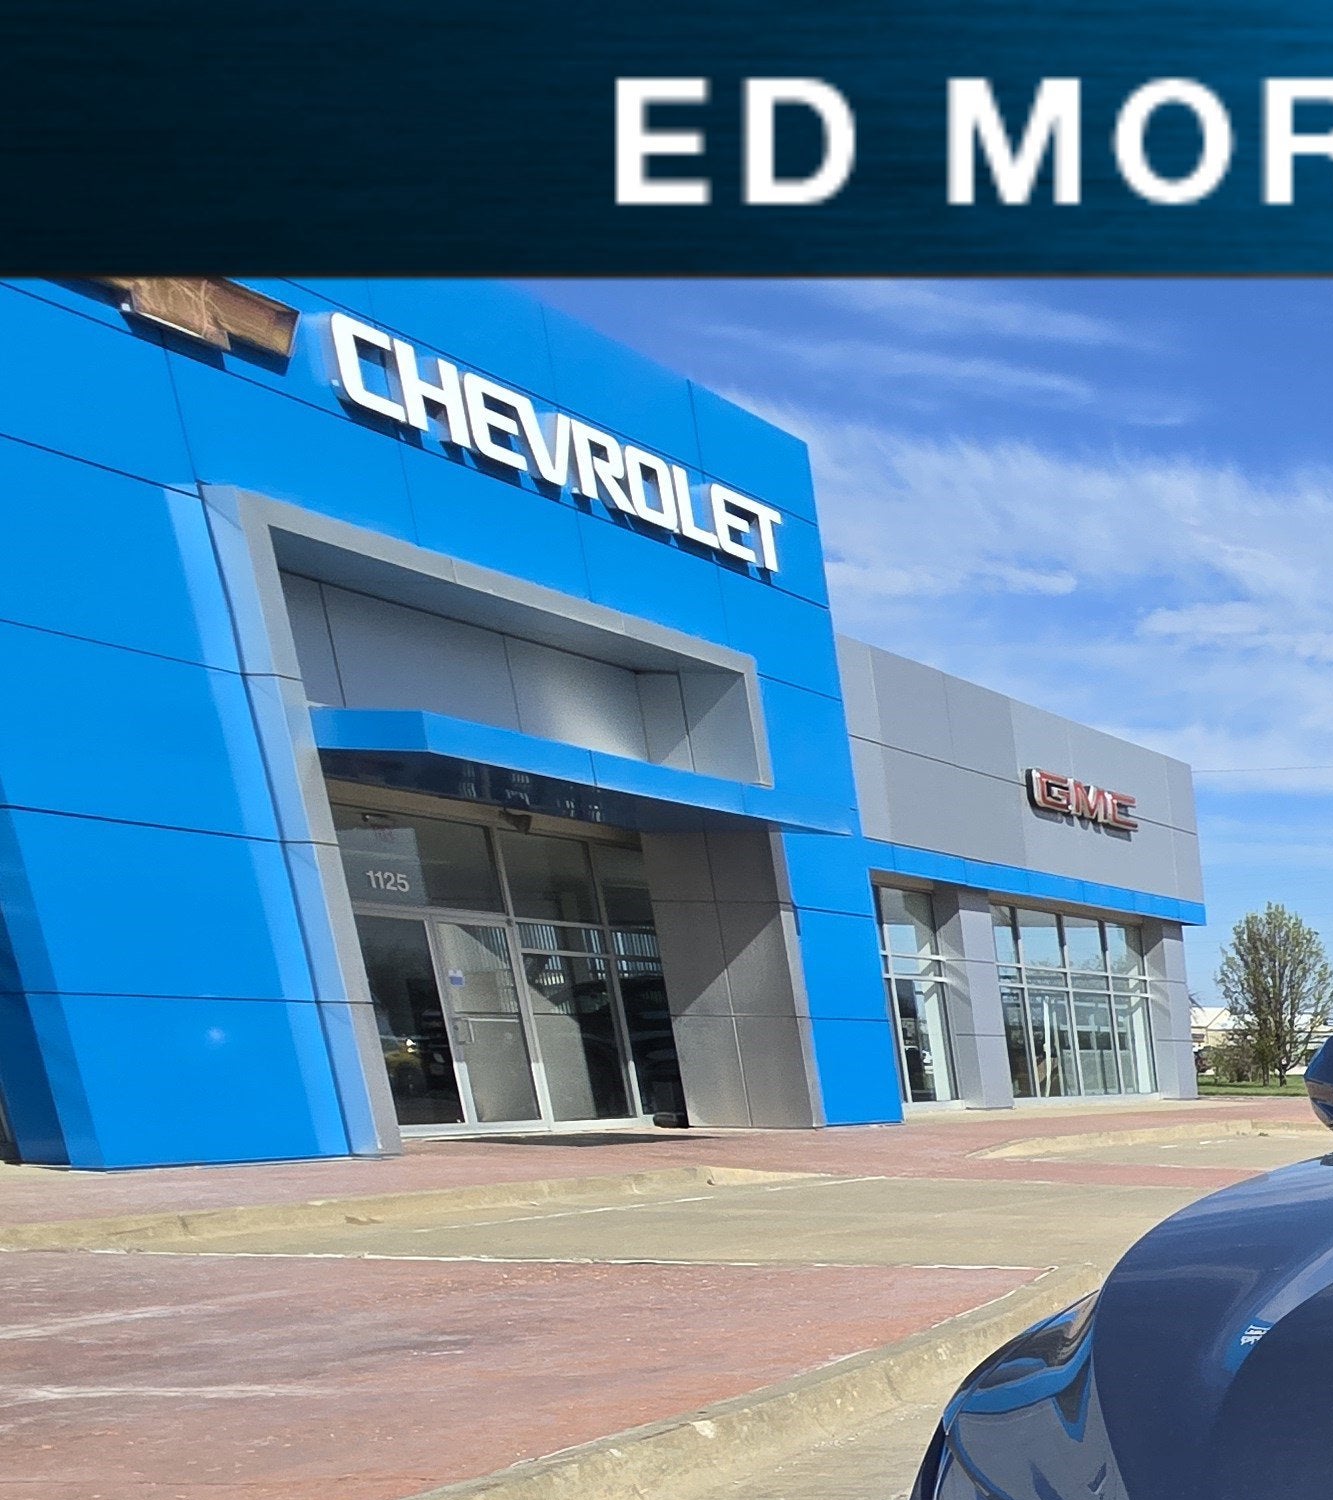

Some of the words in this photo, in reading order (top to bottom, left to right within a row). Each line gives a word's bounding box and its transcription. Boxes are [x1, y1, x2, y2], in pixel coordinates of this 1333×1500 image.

[331, 311, 783, 573] CHEVROLET
[1028, 768, 1138, 832] GMC
[366, 870, 410, 892] 1125
